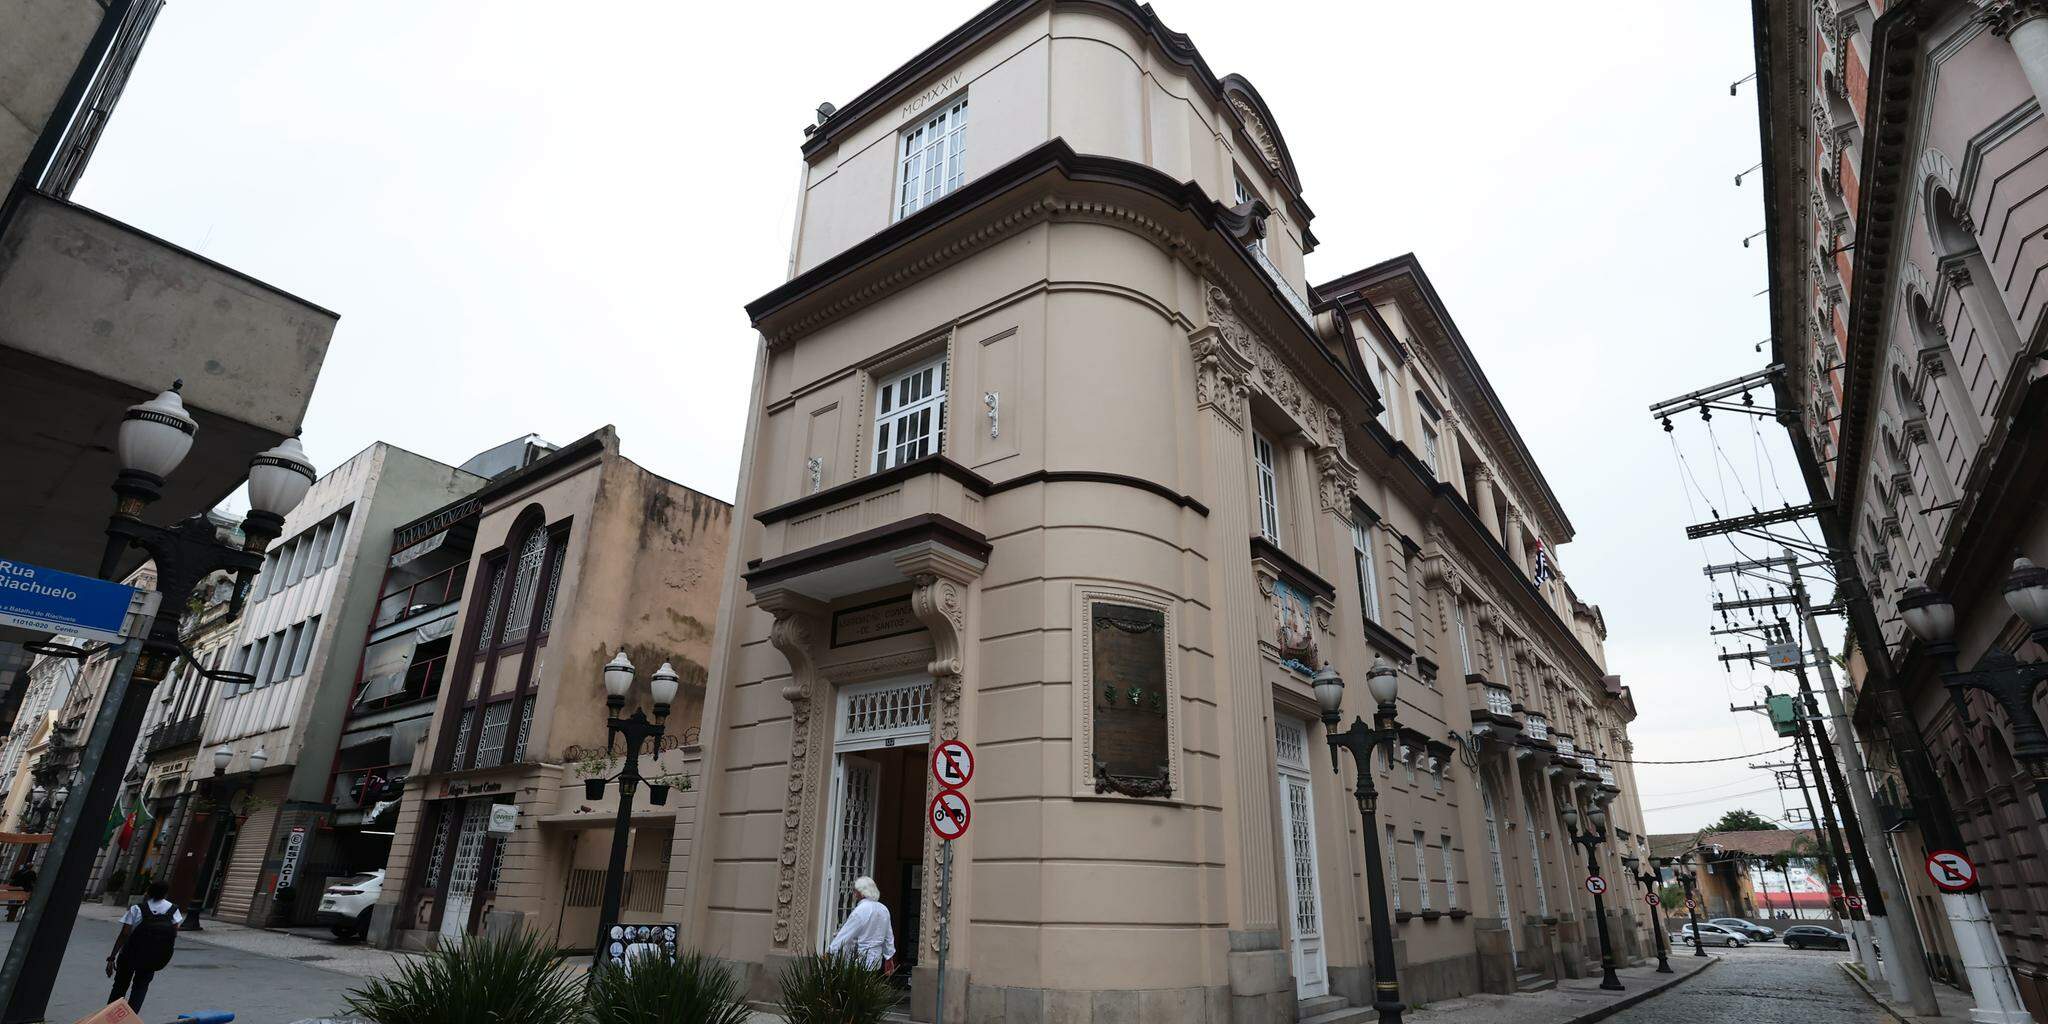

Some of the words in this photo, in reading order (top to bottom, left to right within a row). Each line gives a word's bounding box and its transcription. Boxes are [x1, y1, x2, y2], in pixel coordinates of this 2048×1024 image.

[902, 71, 962, 118] MCMXXIV
[0, 560, 35, 578] Rua
[12, 617, 49, 630] 11010-020
[54, 625, 79, 634] Centro
